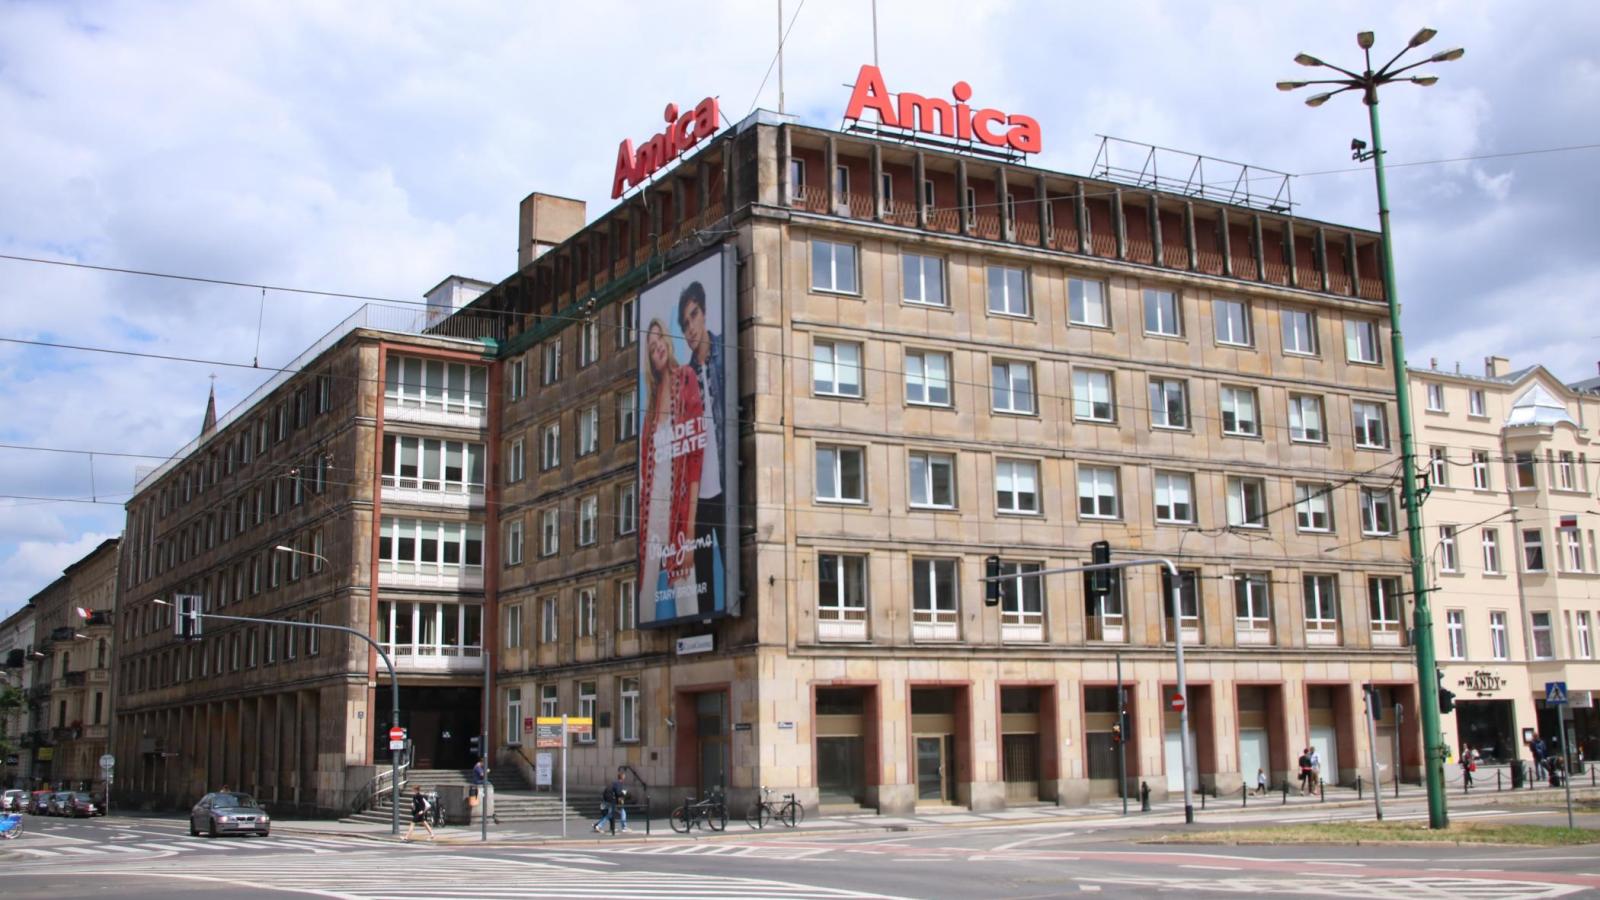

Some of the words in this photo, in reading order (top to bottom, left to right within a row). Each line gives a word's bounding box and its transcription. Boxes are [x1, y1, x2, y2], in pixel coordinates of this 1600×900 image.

[611, 96, 719, 199] Amica
[845, 64, 1041, 154] Amica
[1465, 676, 1500, 690] WANDY
